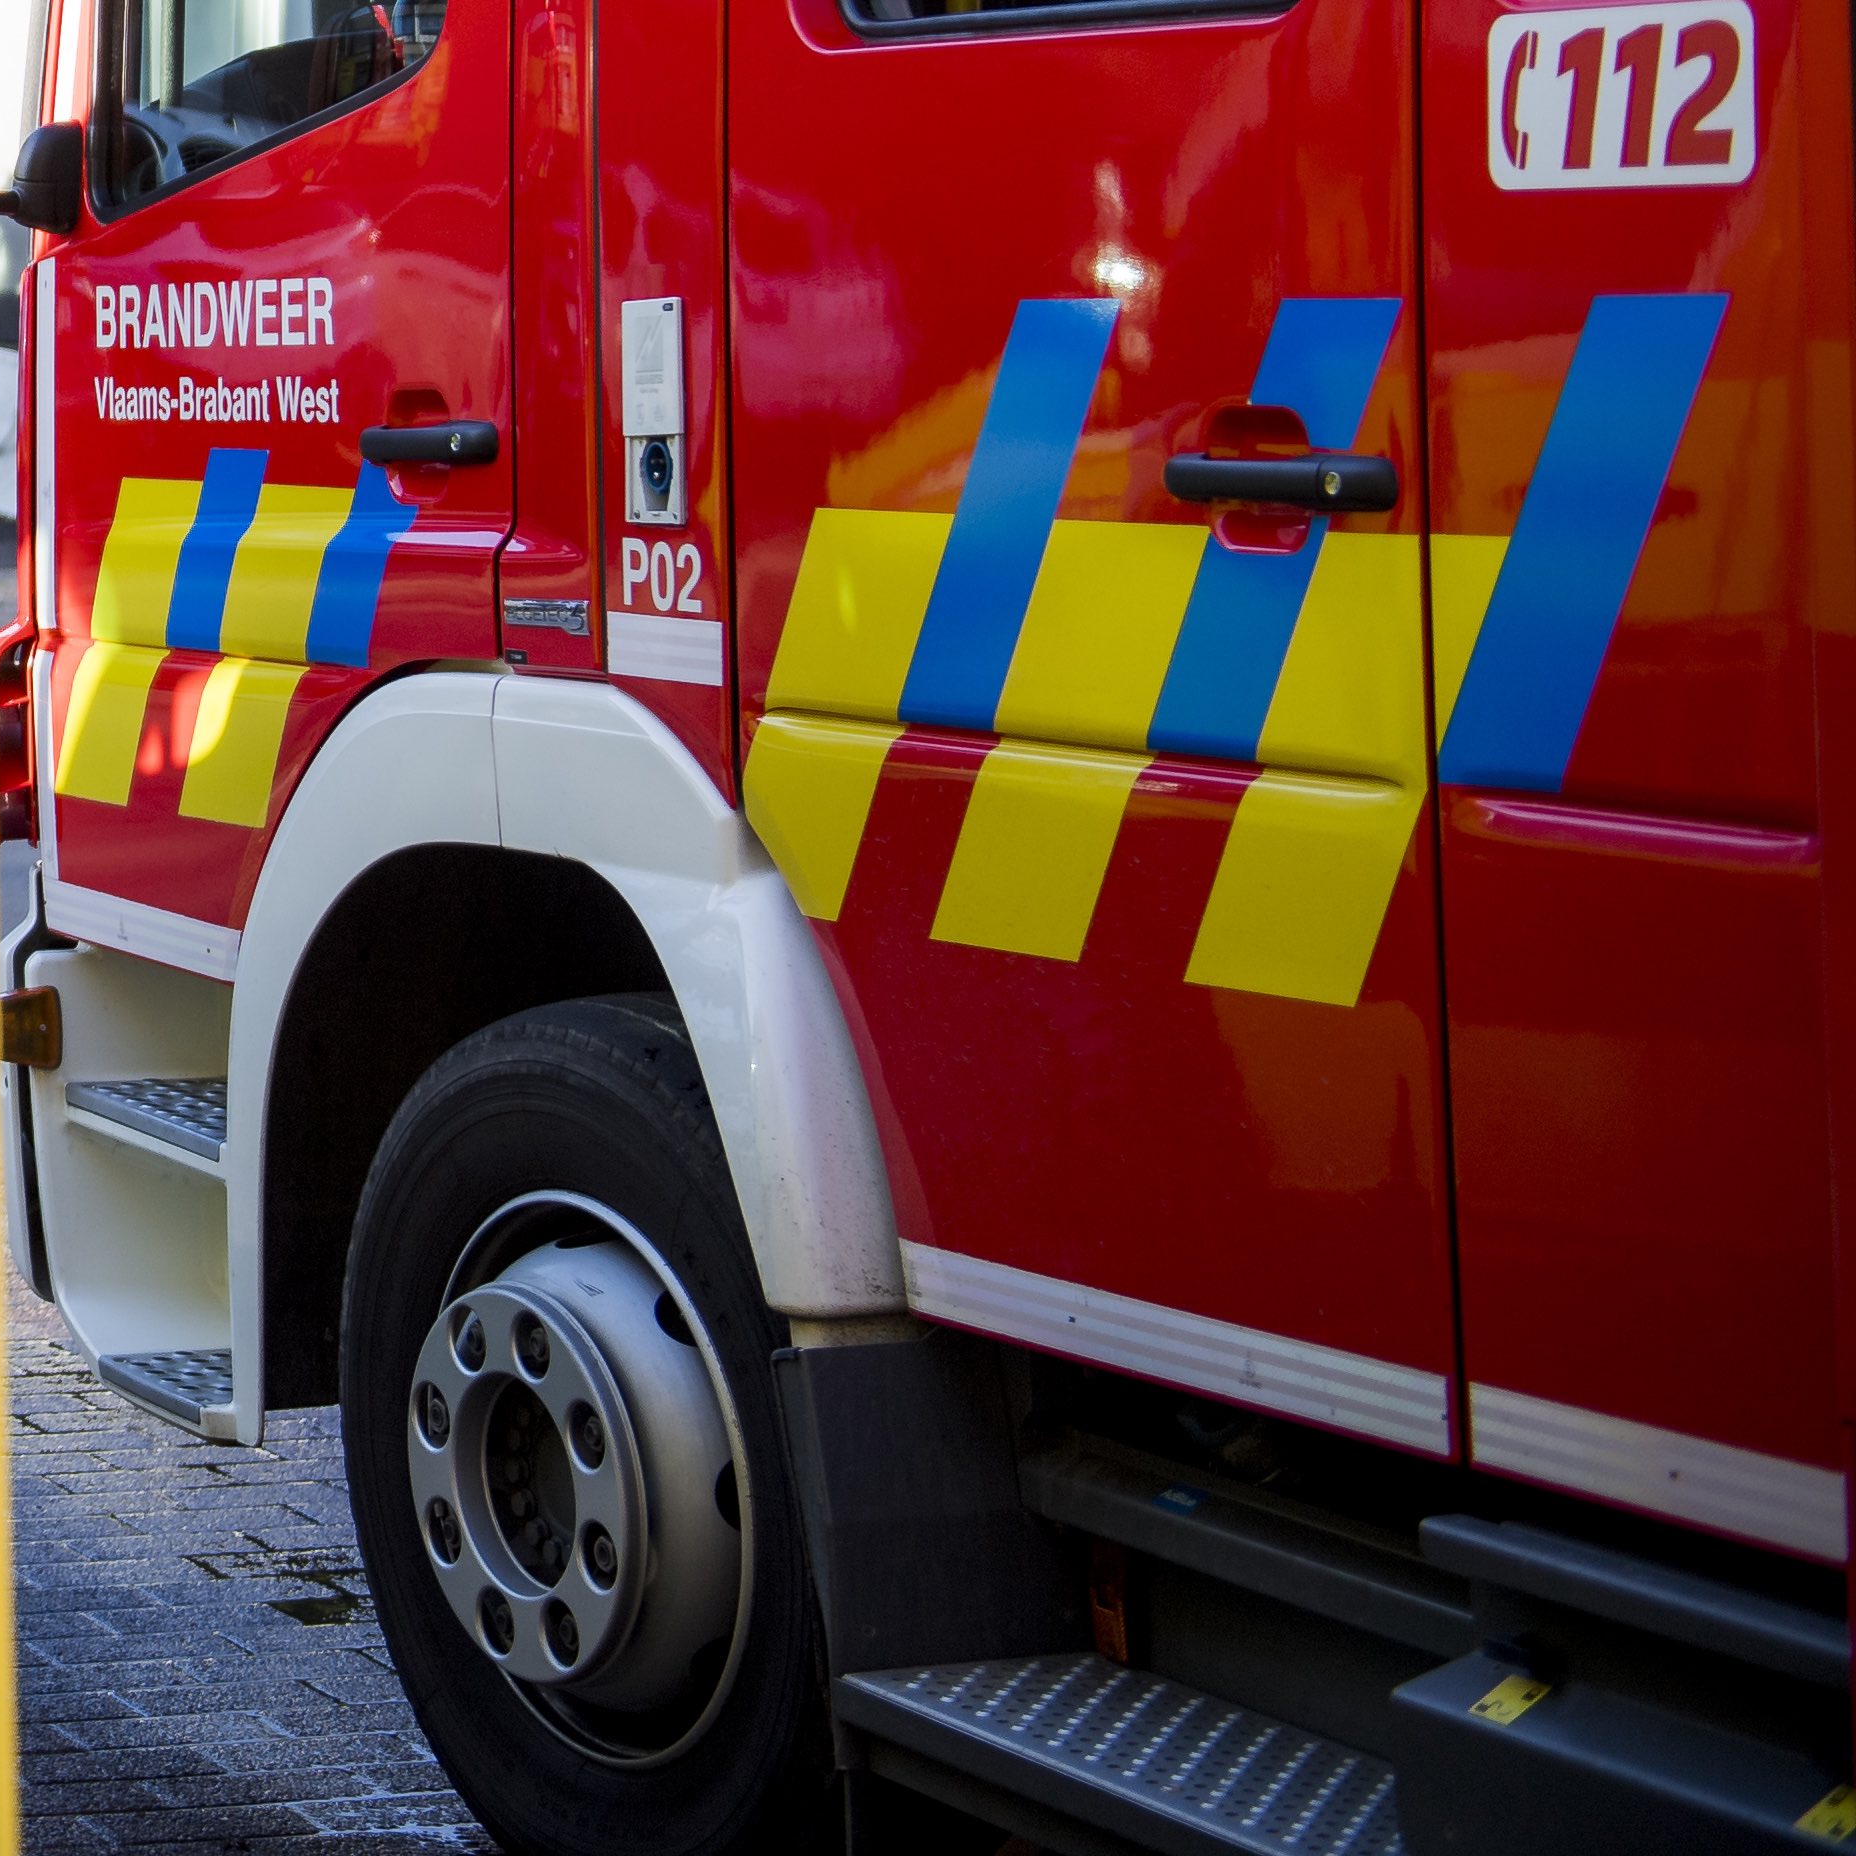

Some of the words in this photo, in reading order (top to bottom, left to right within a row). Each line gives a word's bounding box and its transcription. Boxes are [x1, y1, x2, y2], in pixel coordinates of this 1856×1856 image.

[1557, 19, 1741, 170] 112
[95, 277, 335, 349] BRANDWEER
[94, 376, 271, 423] Vlaams-Brabant
[275, 375, 340, 423] West
[622, 537, 703, 614] P02
